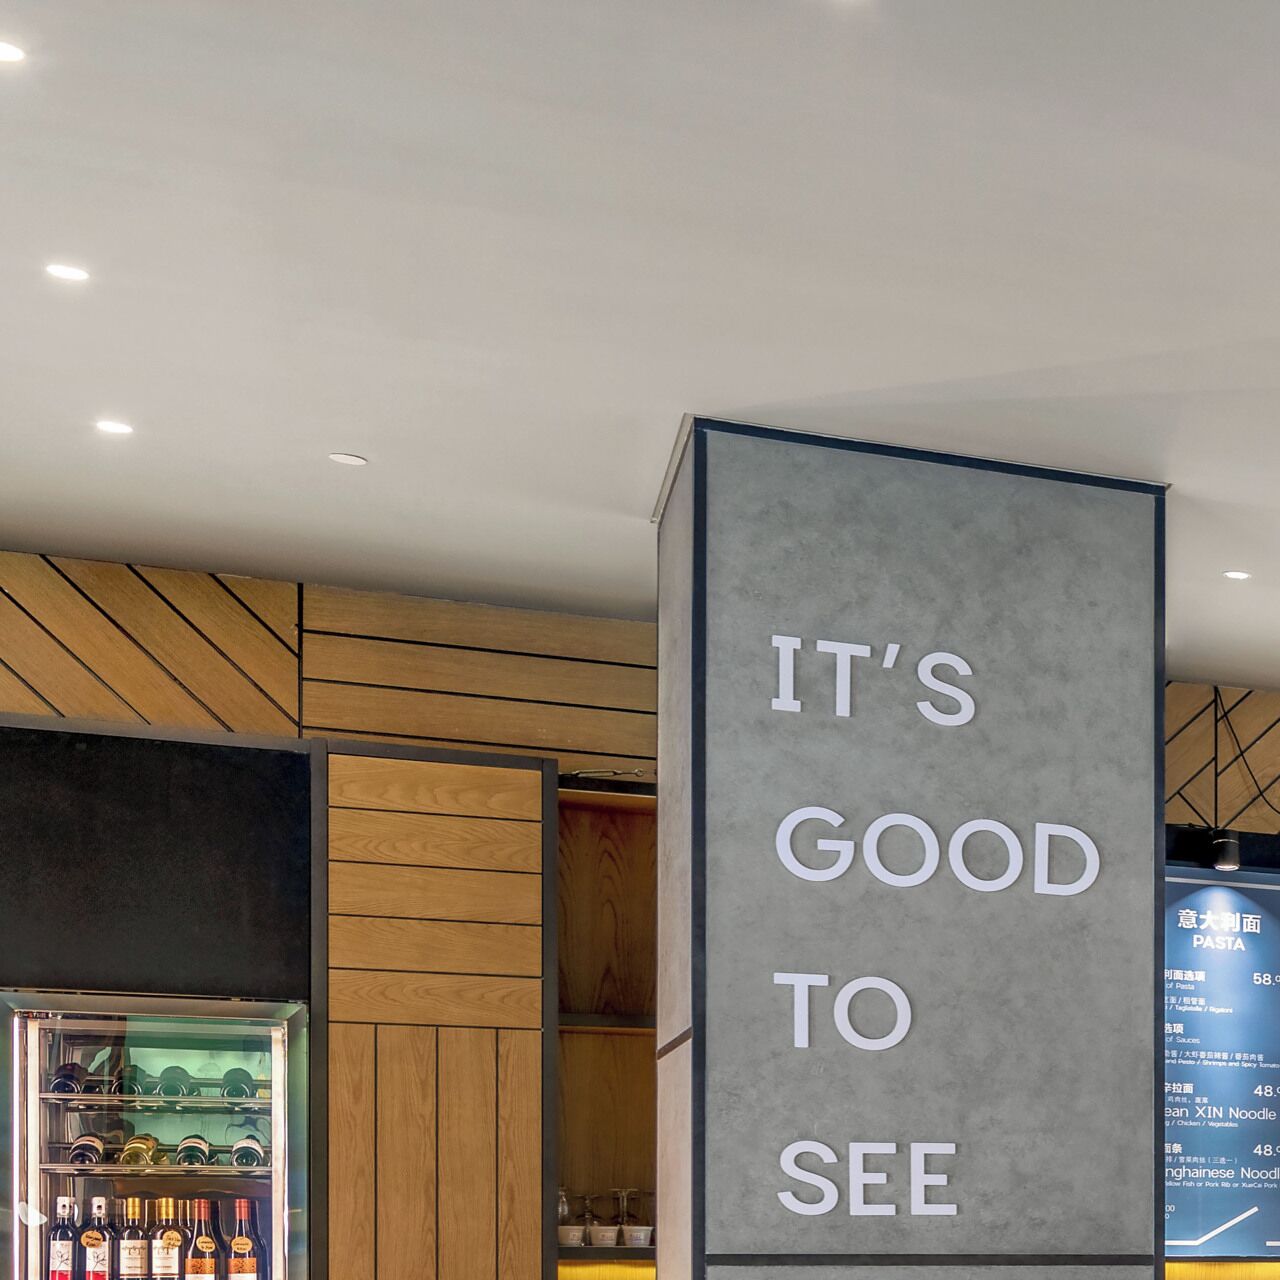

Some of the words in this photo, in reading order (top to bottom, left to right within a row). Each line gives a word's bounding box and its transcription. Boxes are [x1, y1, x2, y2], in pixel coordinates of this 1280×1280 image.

[771, 635, 975, 726] IT'S
[776, 806, 1100, 896] GOOD
[1178, 909, 1262, 933] 意大利面
[1192, 935, 1246, 951] PASTA
[773, 972, 911, 1050] TO
[1195, 1106, 1223, 1119] XIN
[1229, 1107, 1277, 1120] Noodle
[777, 1140, 958, 1218] SEE
